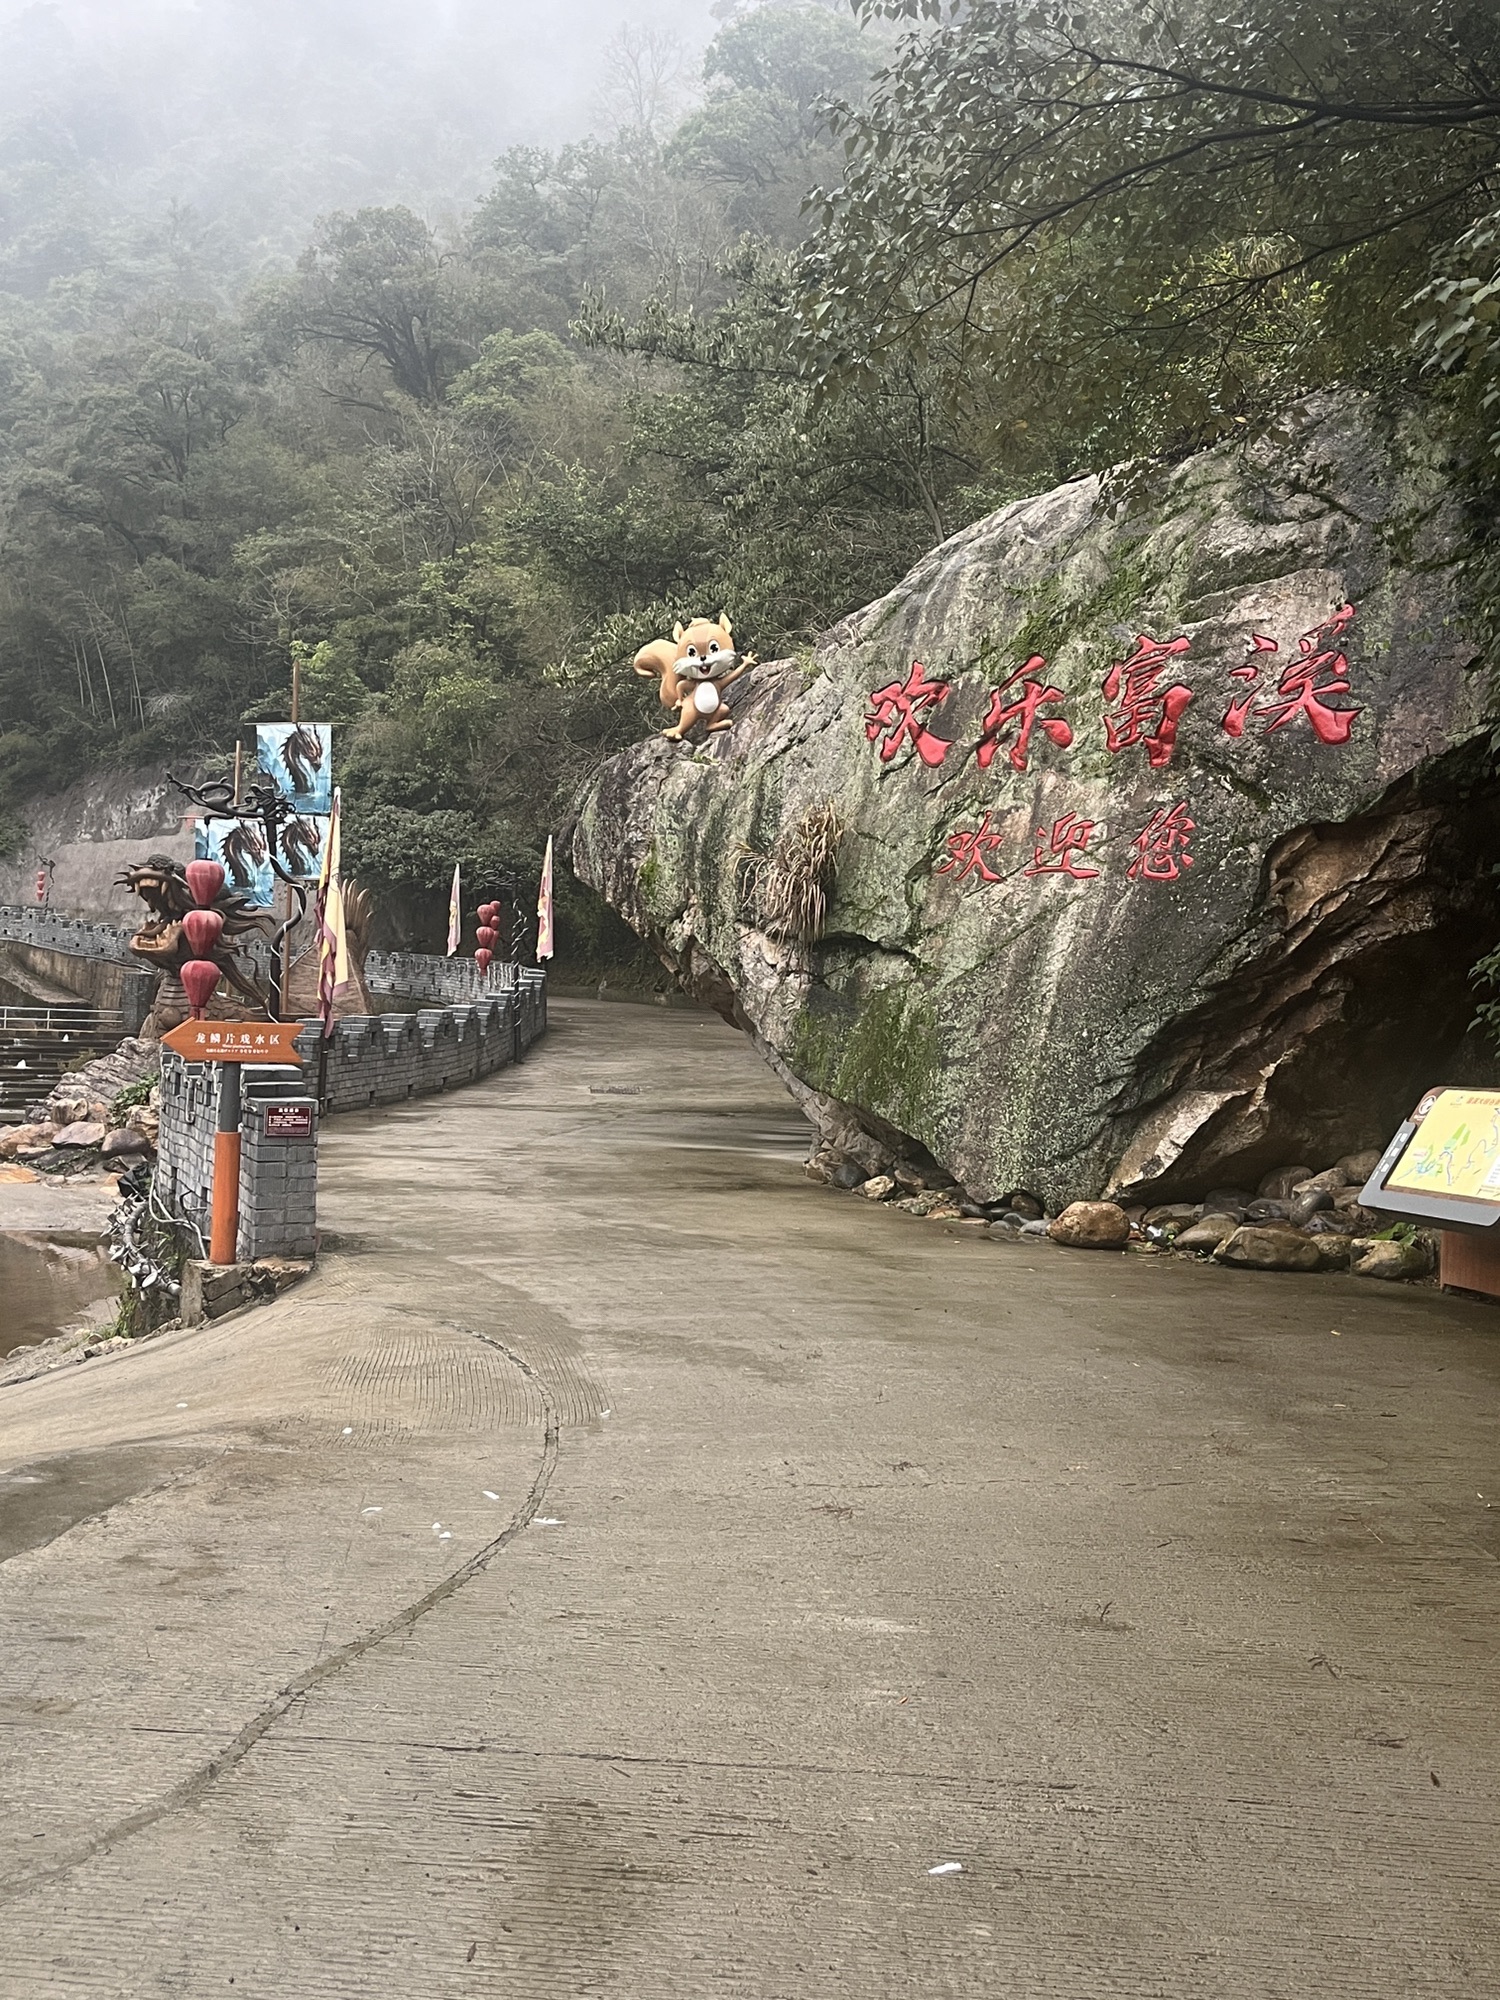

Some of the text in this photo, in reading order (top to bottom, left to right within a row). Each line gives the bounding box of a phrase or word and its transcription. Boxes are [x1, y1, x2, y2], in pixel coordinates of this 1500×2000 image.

[938, 801, 1197, 881] 欢迎您
[195, 1032, 280, 1045] 龙鳞片戏水区
